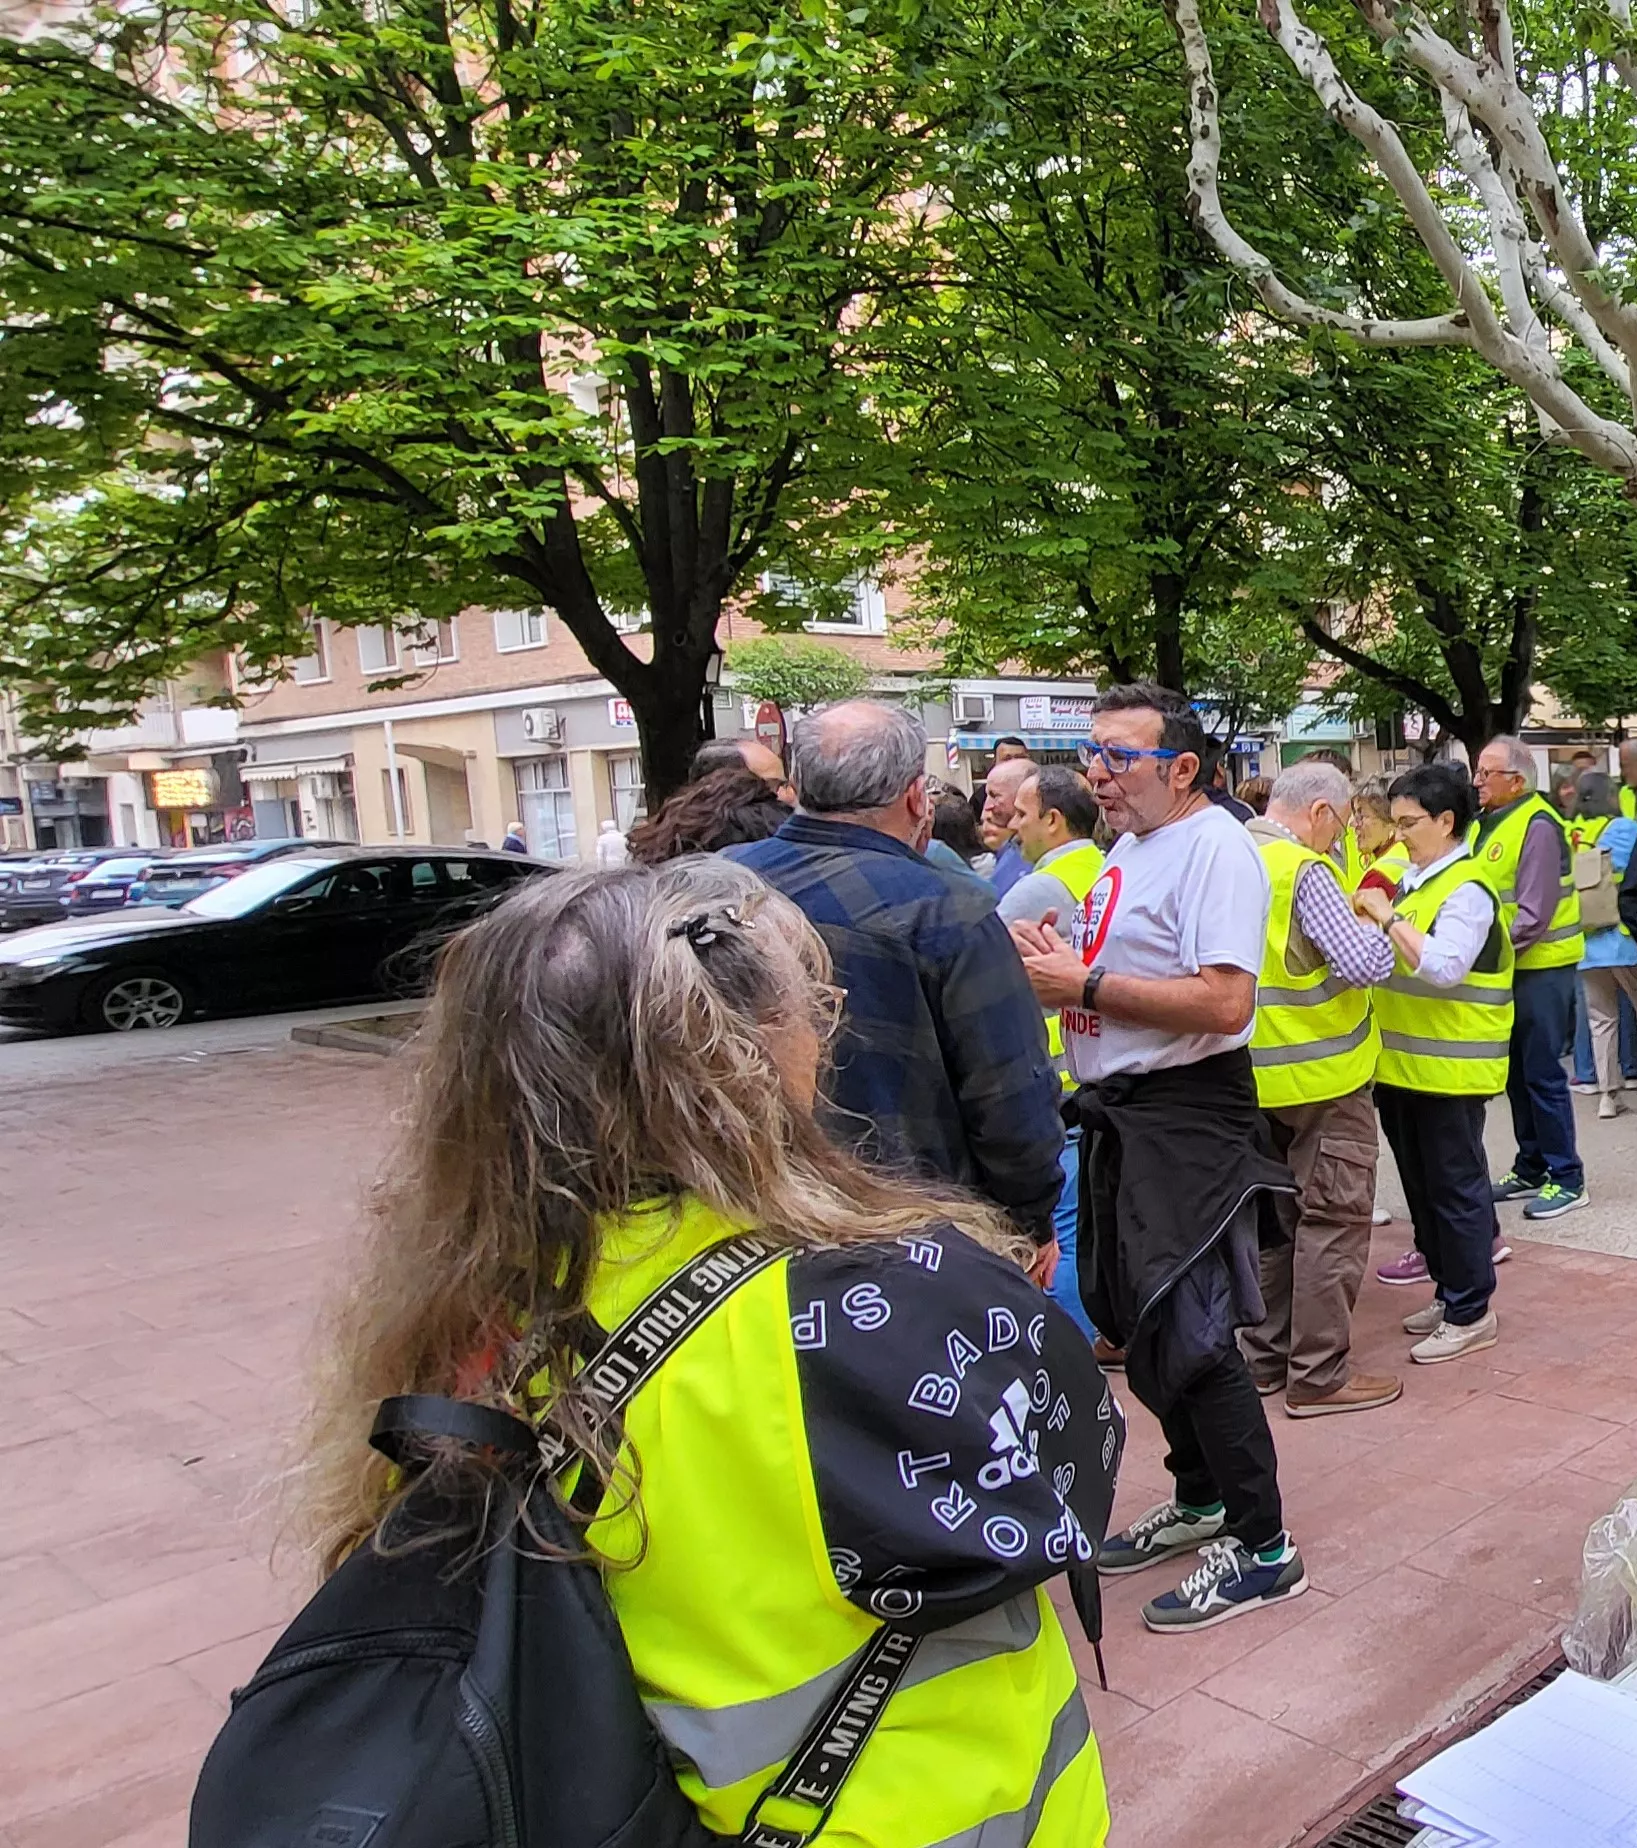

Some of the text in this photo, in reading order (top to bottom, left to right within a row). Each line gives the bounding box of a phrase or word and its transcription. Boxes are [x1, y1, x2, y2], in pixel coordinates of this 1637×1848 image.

[1061, 1007, 1101, 1038] NDE
[623, 1289, 703, 1361] TRUE
[821, 1673, 890, 1759] MTNG
[873, 1631, 914, 1666] TR
